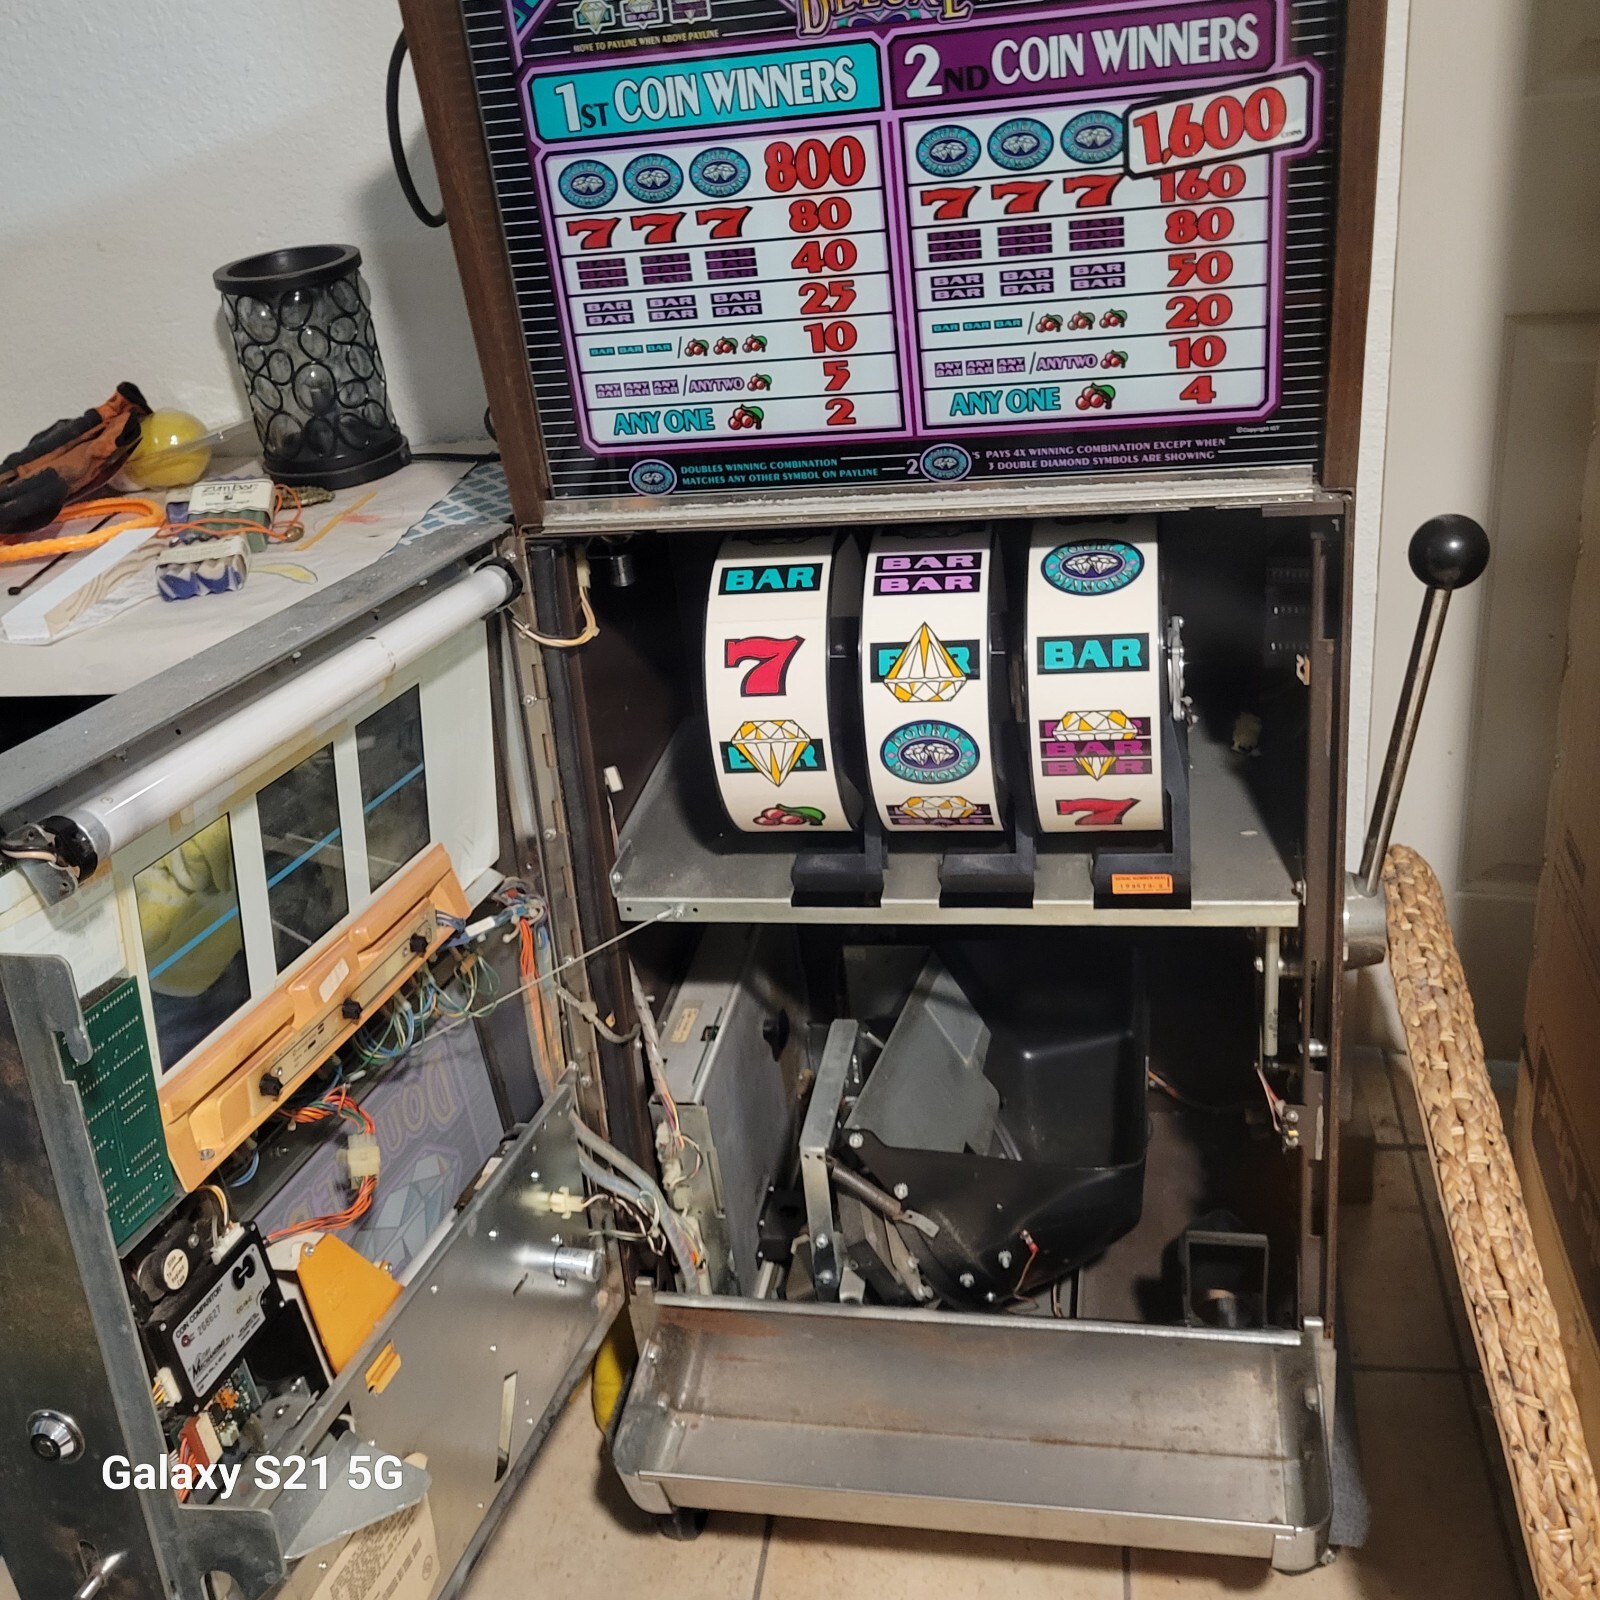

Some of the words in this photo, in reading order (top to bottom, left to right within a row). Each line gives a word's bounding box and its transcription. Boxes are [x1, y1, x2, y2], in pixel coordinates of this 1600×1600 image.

[627, 12, 658, 20] BAR
[573, 44, 594, 52] MOVE
[595, 42, 606, 51] TO
[607, 38, 638, 48] PAYLINE
[638, 36, 661, 45] WHEN
[662, 32, 687, 43] ABOVE
[688, 29, 719, 40] PAYLINE
[904, 43, 989, 99] 2ND
[990, 33, 1083, 86] COIN
[1089, 12, 1260, 74] WINNERS
[555, 82, 609, 133] 1ST
[614, 74, 700, 124] COIN
[704, 56, 858, 114] WINNERS
[1132, 86, 1287, 166] 1,600
[764, 135, 866, 193] 800
[920, 185, 982, 221] 7
[990, 180, 1053, 215] 7
[1062, 173, 1126, 209] 7
[1154, 164, 1246, 202] 160
[566, 217, 622, 250] 7
[630, 212, 687, 246] 7
[696, 206, 753, 240] 7
[788, 196, 852, 234] 80
[929, 230, 979, 241] BAR
[1000, 224, 1050, 234] BAR
[1070, 218, 1122, 228] BAR
[1164, 206, 1235, 245] 80
[930, 240, 980, 251] BAR
[1000, 234, 1051, 246] BAR
[1071, 228, 1122, 240] BAR
[931, 251, 980, 262] BAR
[1000, 246, 1051, 256] BAR
[1072, 239, 1123, 250] BAR
[578, 258, 624, 270] BAR
[642, 254, 689, 264] BAR
[707, 248, 754, 259] BAR
[580, 268, 626, 280] BAR
[644, 264, 690, 274] BAR
[708, 258, 755, 269] BAR
[791, 239, 858, 275] 40
[1167, 250, 1234, 288] 50
[582, 278, 628, 290] BAR
[644, 274, 692, 284] BAR
[709, 269, 756, 280] BAR
[933, 274, 980, 286] BAR
[1002, 268, 1051, 280] BAR
[1073, 263, 1122, 276] BAR
[586, 301, 630, 312] BAR
[649, 296, 694, 308] BAR
[713, 291, 758, 303] BAR
[798, 280, 857, 315] 25
[934, 288, 982, 300] BAR
[1003, 282, 1052, 294] BAR
[1073, 277, 1123, 290] BAR
[588, 314, 632, 325] BAR
[650, 309, 695, 321] BAR
[714, 304, 760, 316] BAR
[932, 323, 960, 333] BAR
[963, 320, 991, 331] BAR
[994, 318, 1022, 328] BAR
[1166, 293, 1233, 330] 20
[590, 347, 615, 356] BAR
[618, 345, 644, 354] BAR
[647, 343, 672, 352] BAR
[804, 320, 858, 354] 10
[936, 362, 961, 370] ANY
[966, 360, 992, 368] ANY
[998, 358, 1024, 366] ANY
[1169, 334, 1227, 370] 10
[597, 384, 620, 392] ANY
[625, 382, 648, 390] ANY
[653, 380, 677, 388] ANY
[823, 360, 851, 392] 5
[936, 368, 962, 376] BAR
[967, 366, 993, 375] BAR
[998, 364, 1024, 373] BAR
[598, 390, 621, 398] BAR
[626, 388, 650, 396] BAR
[654, 386, 678, 394] BAR
[950, 390, 1003, 416] ANY
[1006, 386, 1061, 414] ONE
[1179, 375, 1216, 404] 4
[614, 410, 661, 436] ANY
[664, 408, 715, 433] ONE
[825, 398, 856, 426] 2
[681, 464, 723, 474] DOUBLES
[726, 462, 767, 472] WINNING
[770, 458, 838, 470] COMBINATION
[907, 458, 920, 476] 2
[986, 450, 1010, 459] PAYS
[1012, 448, 1027, 458] 4X
[1028, 446, 1074, 456] WINNING
[1076, 442, 1151, 454] COMBINATION
[1154, 439, 1192, 450] EXCEPT
[1195, 438, 1226, 448] WHEN
[996, 460, 1038, 470] DOUBLE
[1040, 457, 1090, 468] DIAMOND
[1092, 455, 1139, 466] SYMBOLS
[1141, 454, 1162, 464] ARE
[1164, 450, 1215, 462] SHOWING
[682, 475, 726, 486] MATCHES
[728, 474, 747, 483] ANY
[749, 472, 780, 482] OTHER
[783, 470, 820, 480] SYMBOL
[822, 469, 837, 479] ON
[840, 467, 879, 478] PAYLINE
[881, 554, 974, 570] BAR
[1052, 540, 1133, 562] DOUBLE
[724, 566, 815, 591] BAR
[879, 575, 973, 593] BAR
[1047, 567, 1134, 594] DIAMOND
[724, 635, 806, 697] 7
[1043, 638, 1142, 670] BAR
[886, 723, 970, 755] DOUBLE
[1046, 740, 1144, 757] BAR
[893, 752, 980, 783] DIAMOND
[1047, 760, 1144, 775] BR
[1055, 798, 1142, 826] 7
